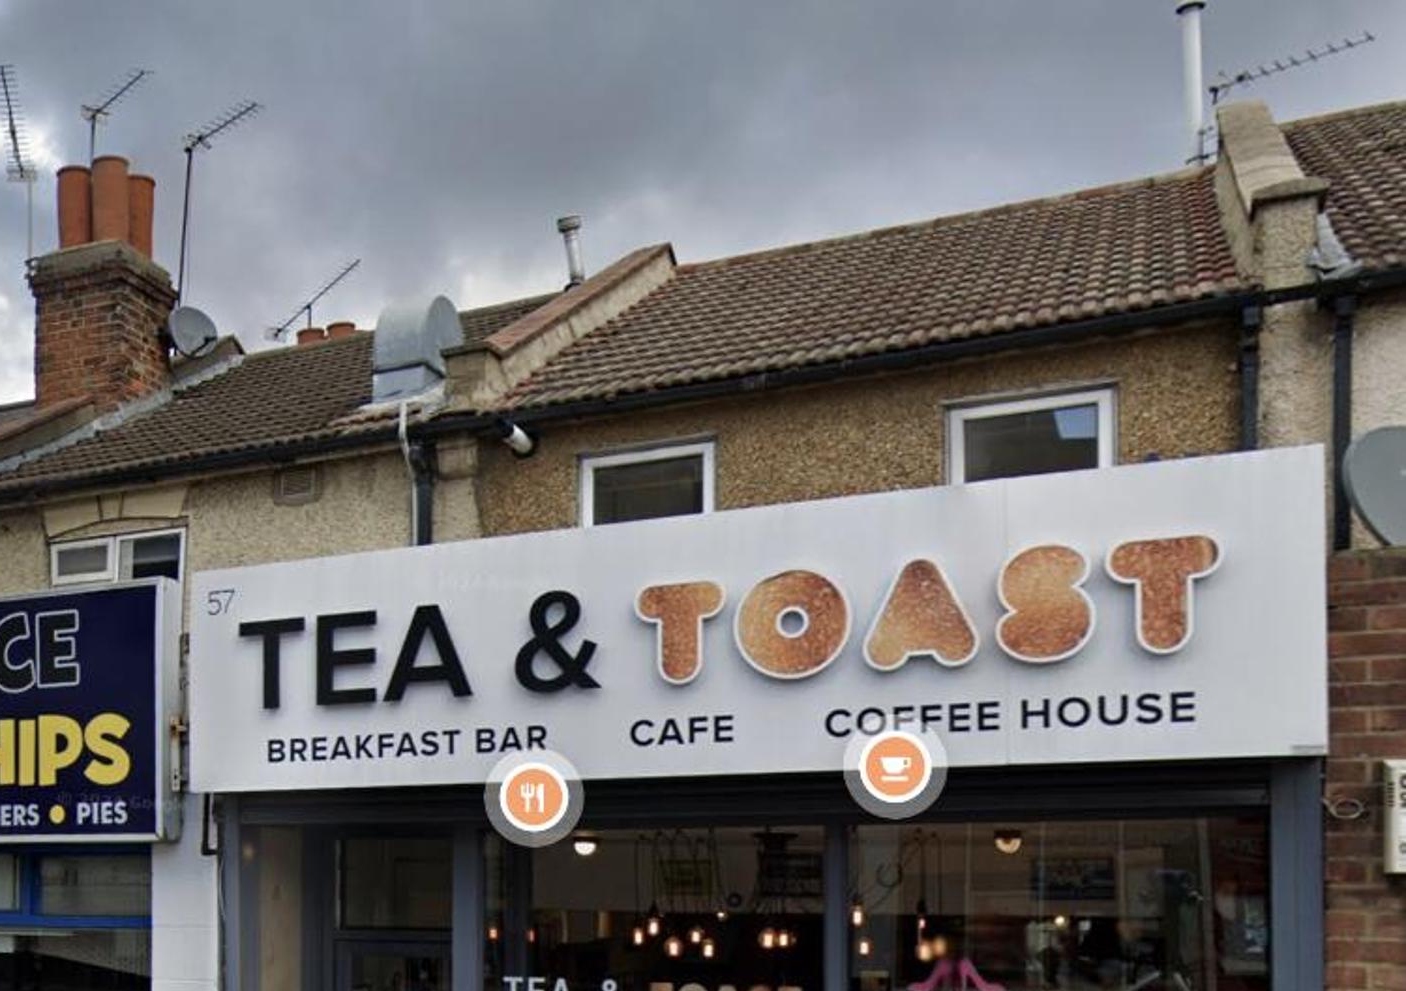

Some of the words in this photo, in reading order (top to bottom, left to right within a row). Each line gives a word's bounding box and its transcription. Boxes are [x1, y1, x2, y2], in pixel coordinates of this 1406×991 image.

[207, 588, 235, 616] 57
[239, 605, 473, 709] TEA
[514, 590, 602, 694] &
[635, 534, 1224, 685] TOAST
[630, 715, 735, 747] CAFE
[825, 701, 1001, 739] COFFEE
[1021, 691, 1198, 730] HOUSE
[268, 730, 461, 763] BREAKFAST
[476, 725, 548, 753] BAR
[76, 800, 128, 826] PIES
